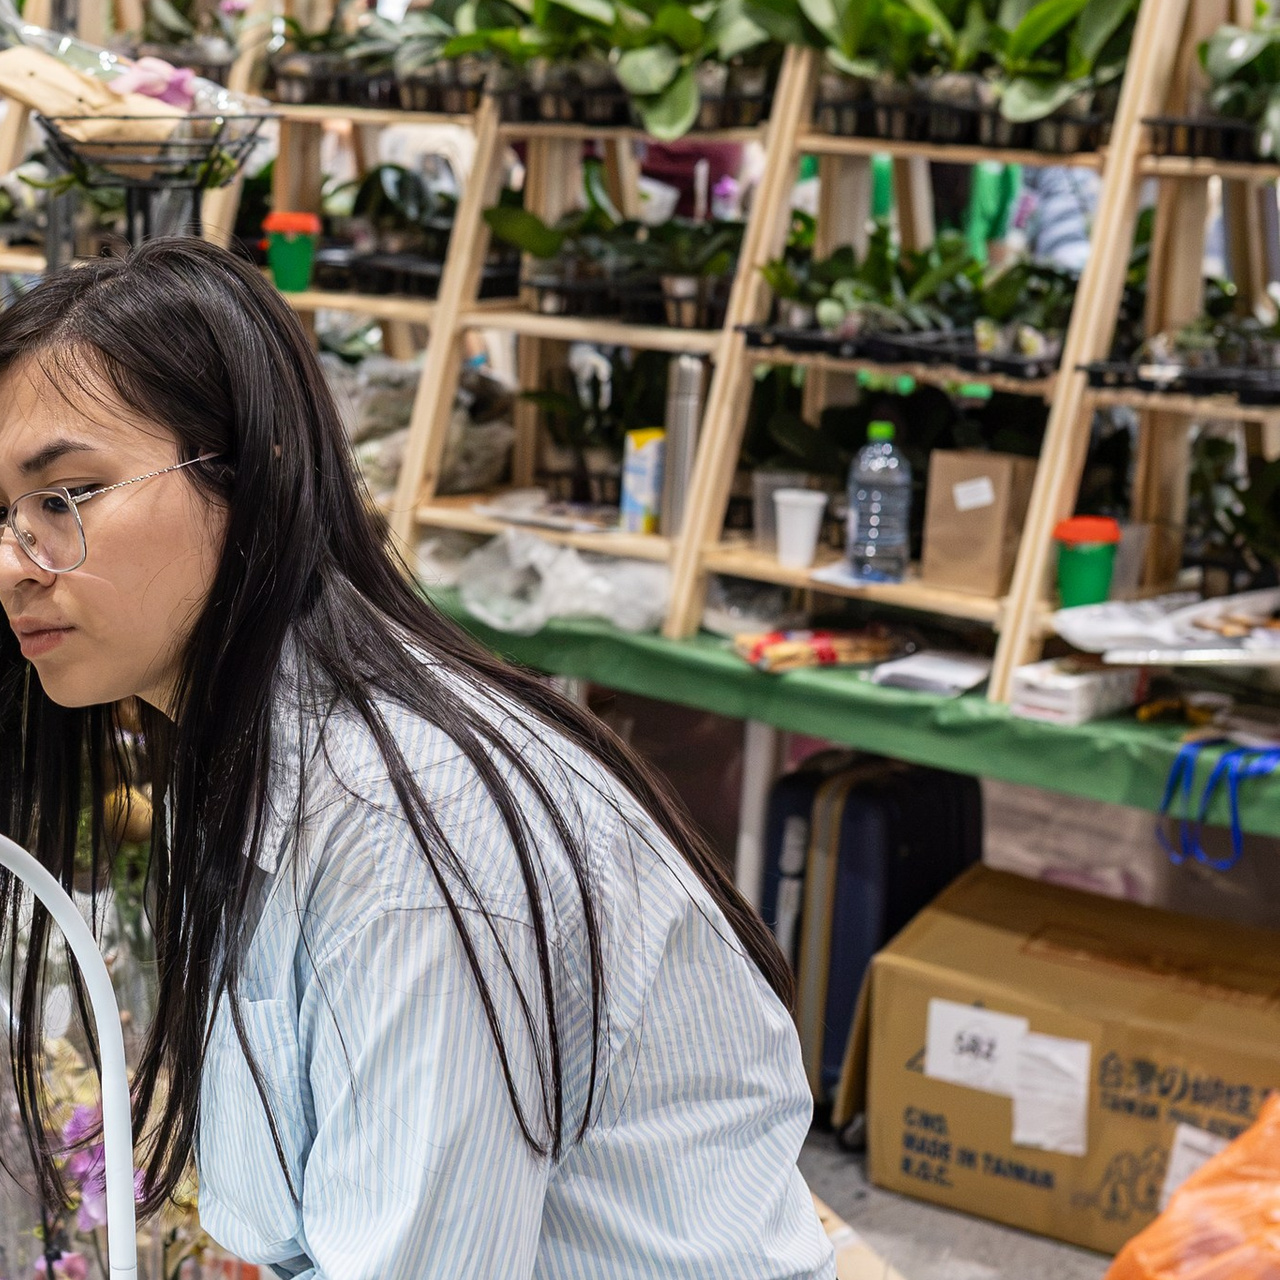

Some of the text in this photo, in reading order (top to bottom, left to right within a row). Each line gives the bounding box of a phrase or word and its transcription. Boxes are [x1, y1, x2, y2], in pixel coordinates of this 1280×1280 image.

[903, 1131, 1056, 1190] MADE IN TAIWAN
